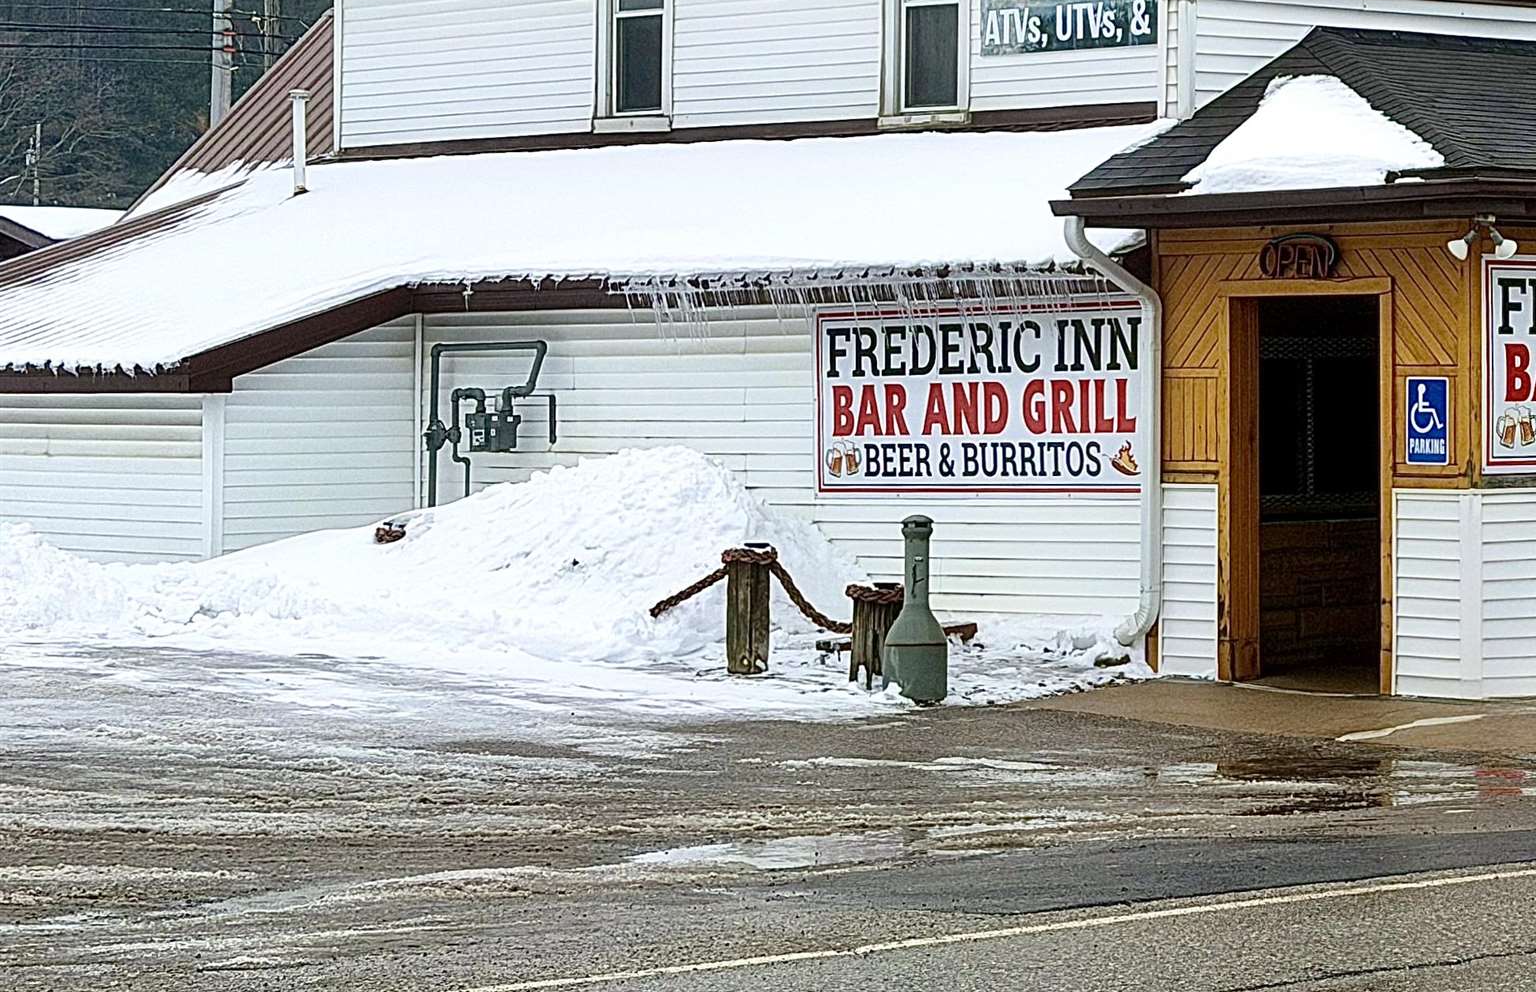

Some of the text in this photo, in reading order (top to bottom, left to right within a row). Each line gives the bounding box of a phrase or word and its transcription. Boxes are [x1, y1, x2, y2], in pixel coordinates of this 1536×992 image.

[984, 7, 1049, 48] ATVs,
[1056, 2, 1122, 42] UTVs,
[1266, 245, 1329, 278] OPEN
[826, 316, 1142, 378] FREDERIC INN
[832, 378, 1137, 437] BAR AND GRILL
[864, 441, 1102, 478] BEER & BURRITOS
[1409, 438, 1445, 454] PARKING
